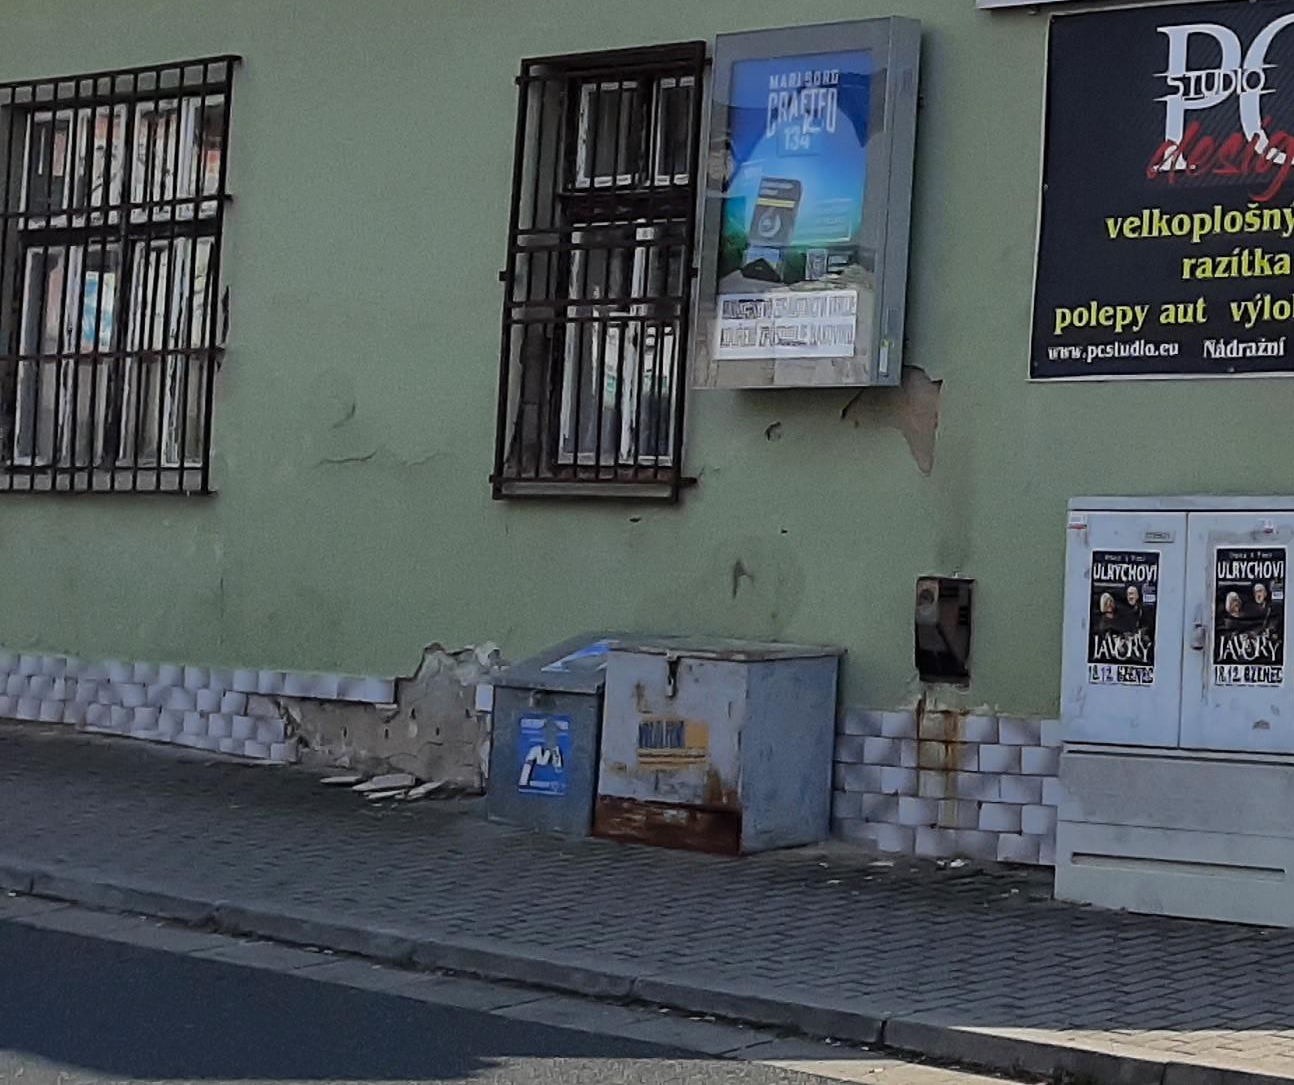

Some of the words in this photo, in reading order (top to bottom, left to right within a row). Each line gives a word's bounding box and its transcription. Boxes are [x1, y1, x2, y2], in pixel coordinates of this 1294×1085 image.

[1181, 248, 1291, 281] razítka
[1053, 299, 1149, 335] polepy
[1159, 297, 1208, 325] aut
